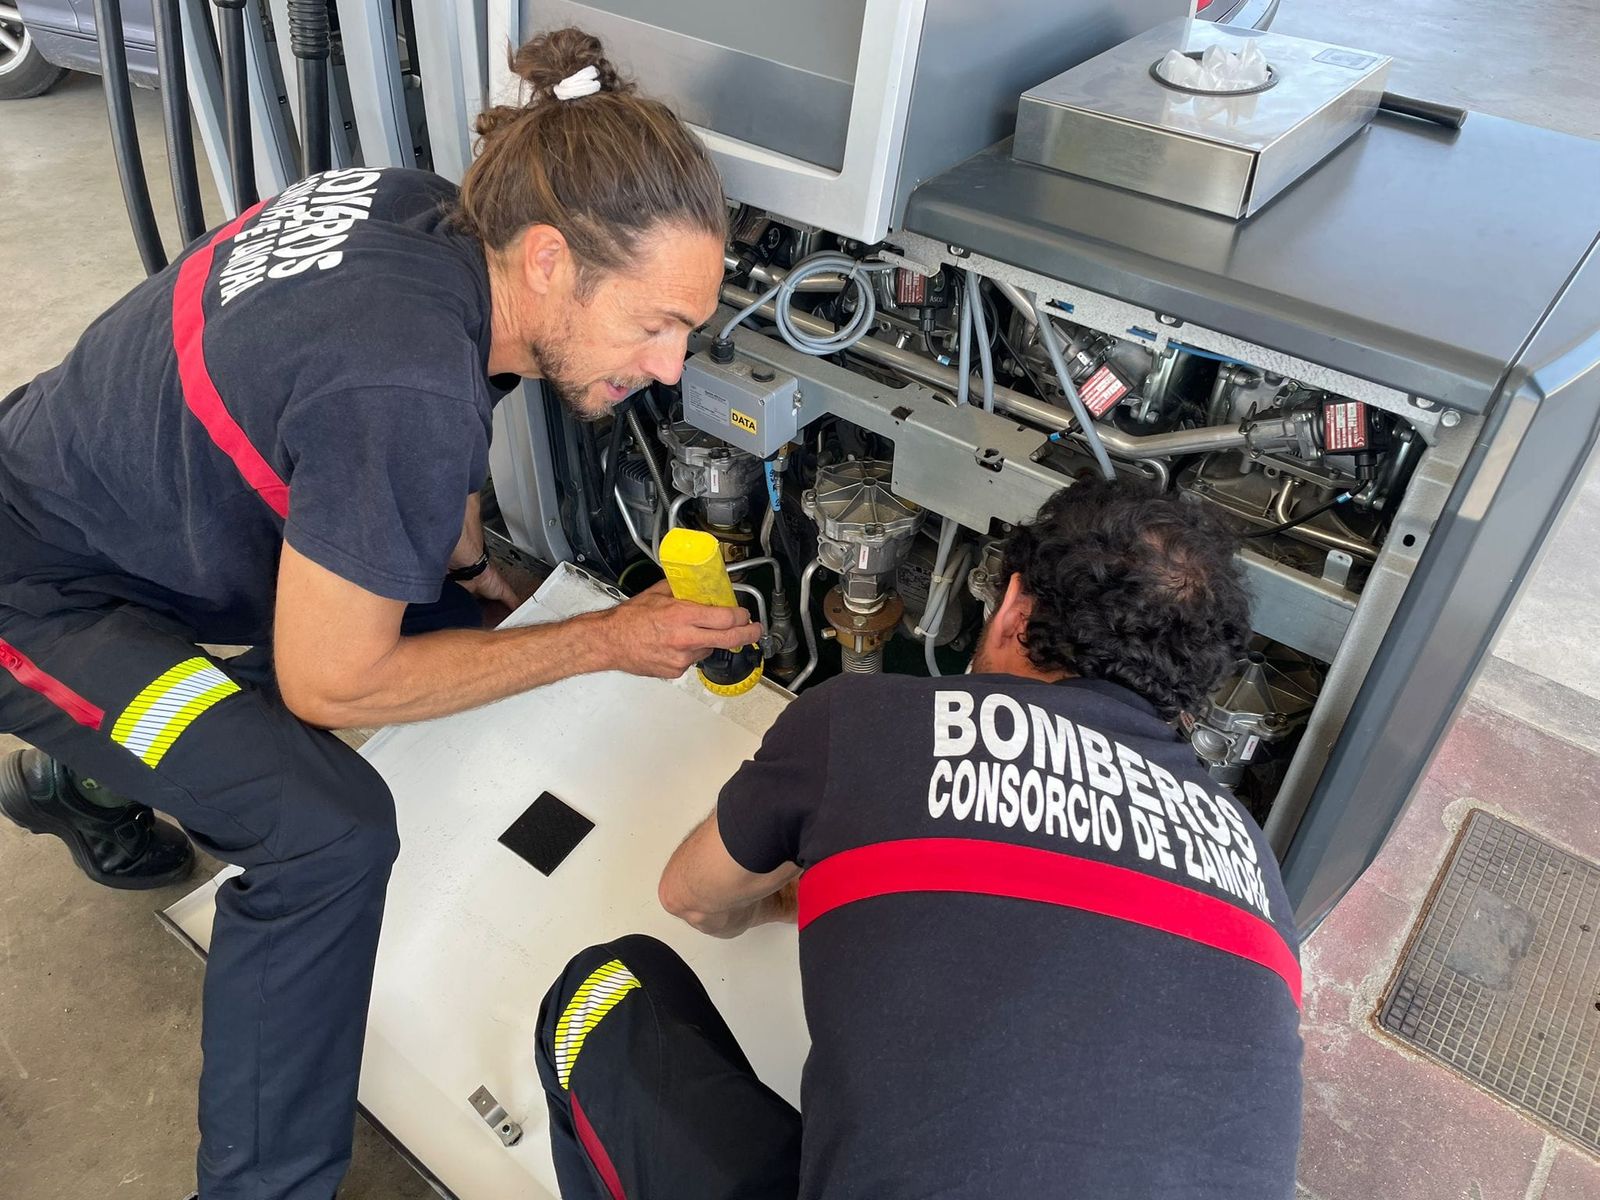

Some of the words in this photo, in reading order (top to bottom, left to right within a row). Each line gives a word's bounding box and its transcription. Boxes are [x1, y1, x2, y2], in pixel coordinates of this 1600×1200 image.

[732, 412, 756, 431] DATA
[928, 759, 1123, 852] CONSORCIO
[1129, 805, 1177, 869] DE
[933, 690, 1257, 864] BOMBEROS
